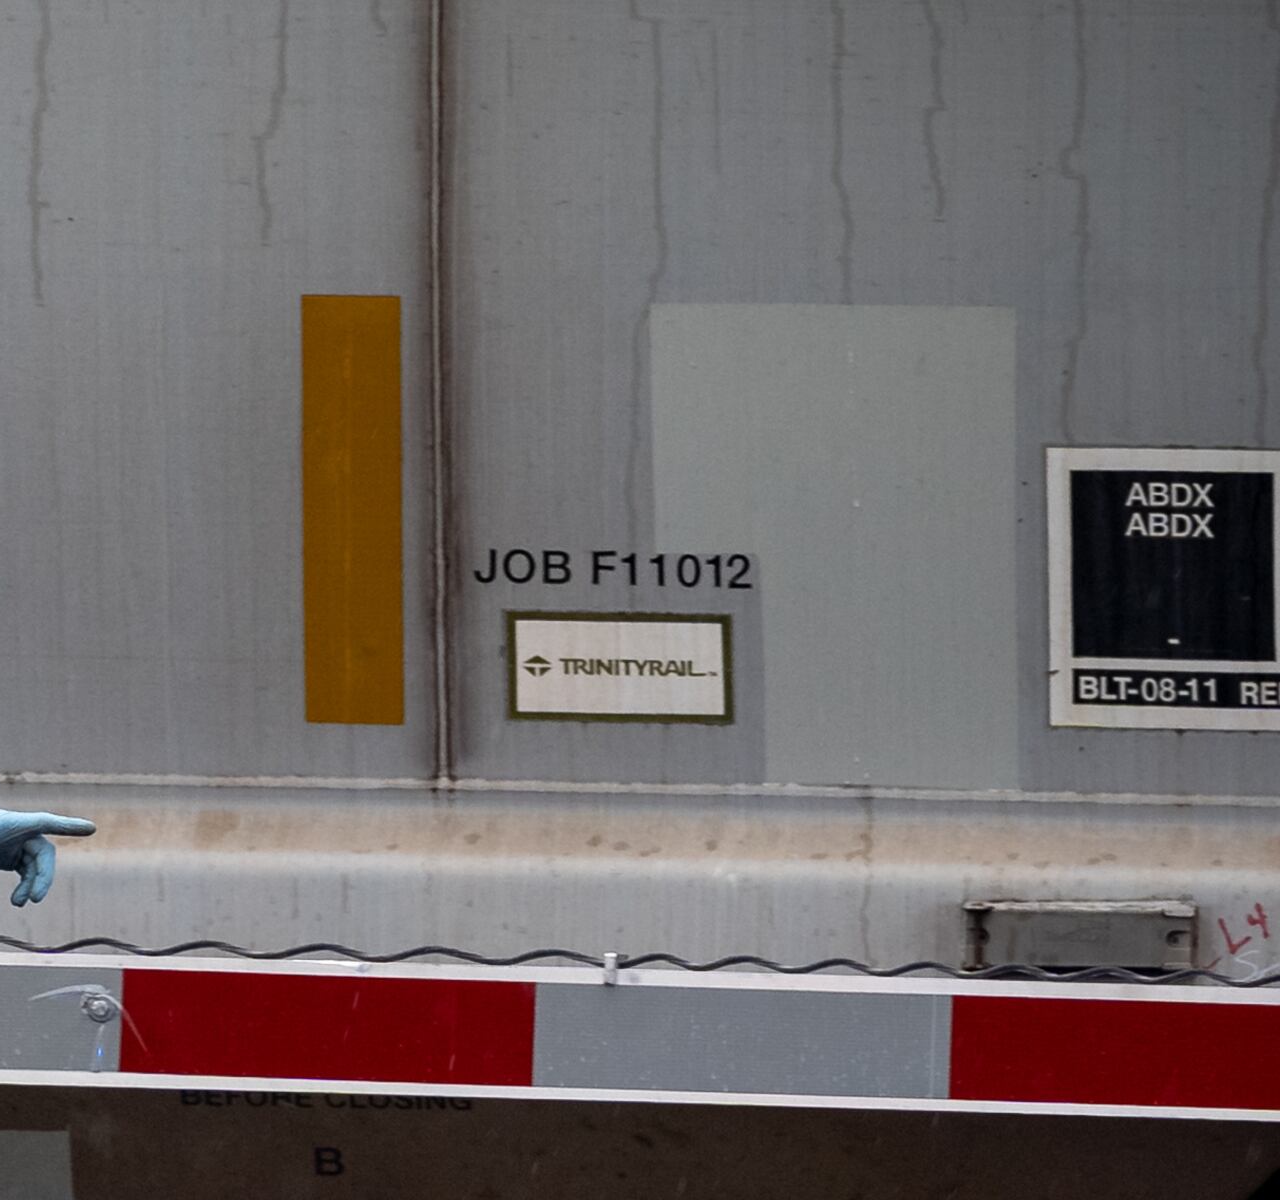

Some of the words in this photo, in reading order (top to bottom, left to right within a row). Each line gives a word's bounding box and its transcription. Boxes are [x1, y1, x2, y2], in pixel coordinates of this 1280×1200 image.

[1125, 483, 1215, 507] ABDX
[1125, 513, 1215, 538] ABDX
[474, 549, 571, 584] JOB
[592, 550, 752, 590] F11012
[559, 658, 707, 677] TRINITYRAIL
[1078, 676, 1218, 702] BLT-08-11
[1240, 682, 1280, 704] RE
[314, 1147, 345, 1176] B
